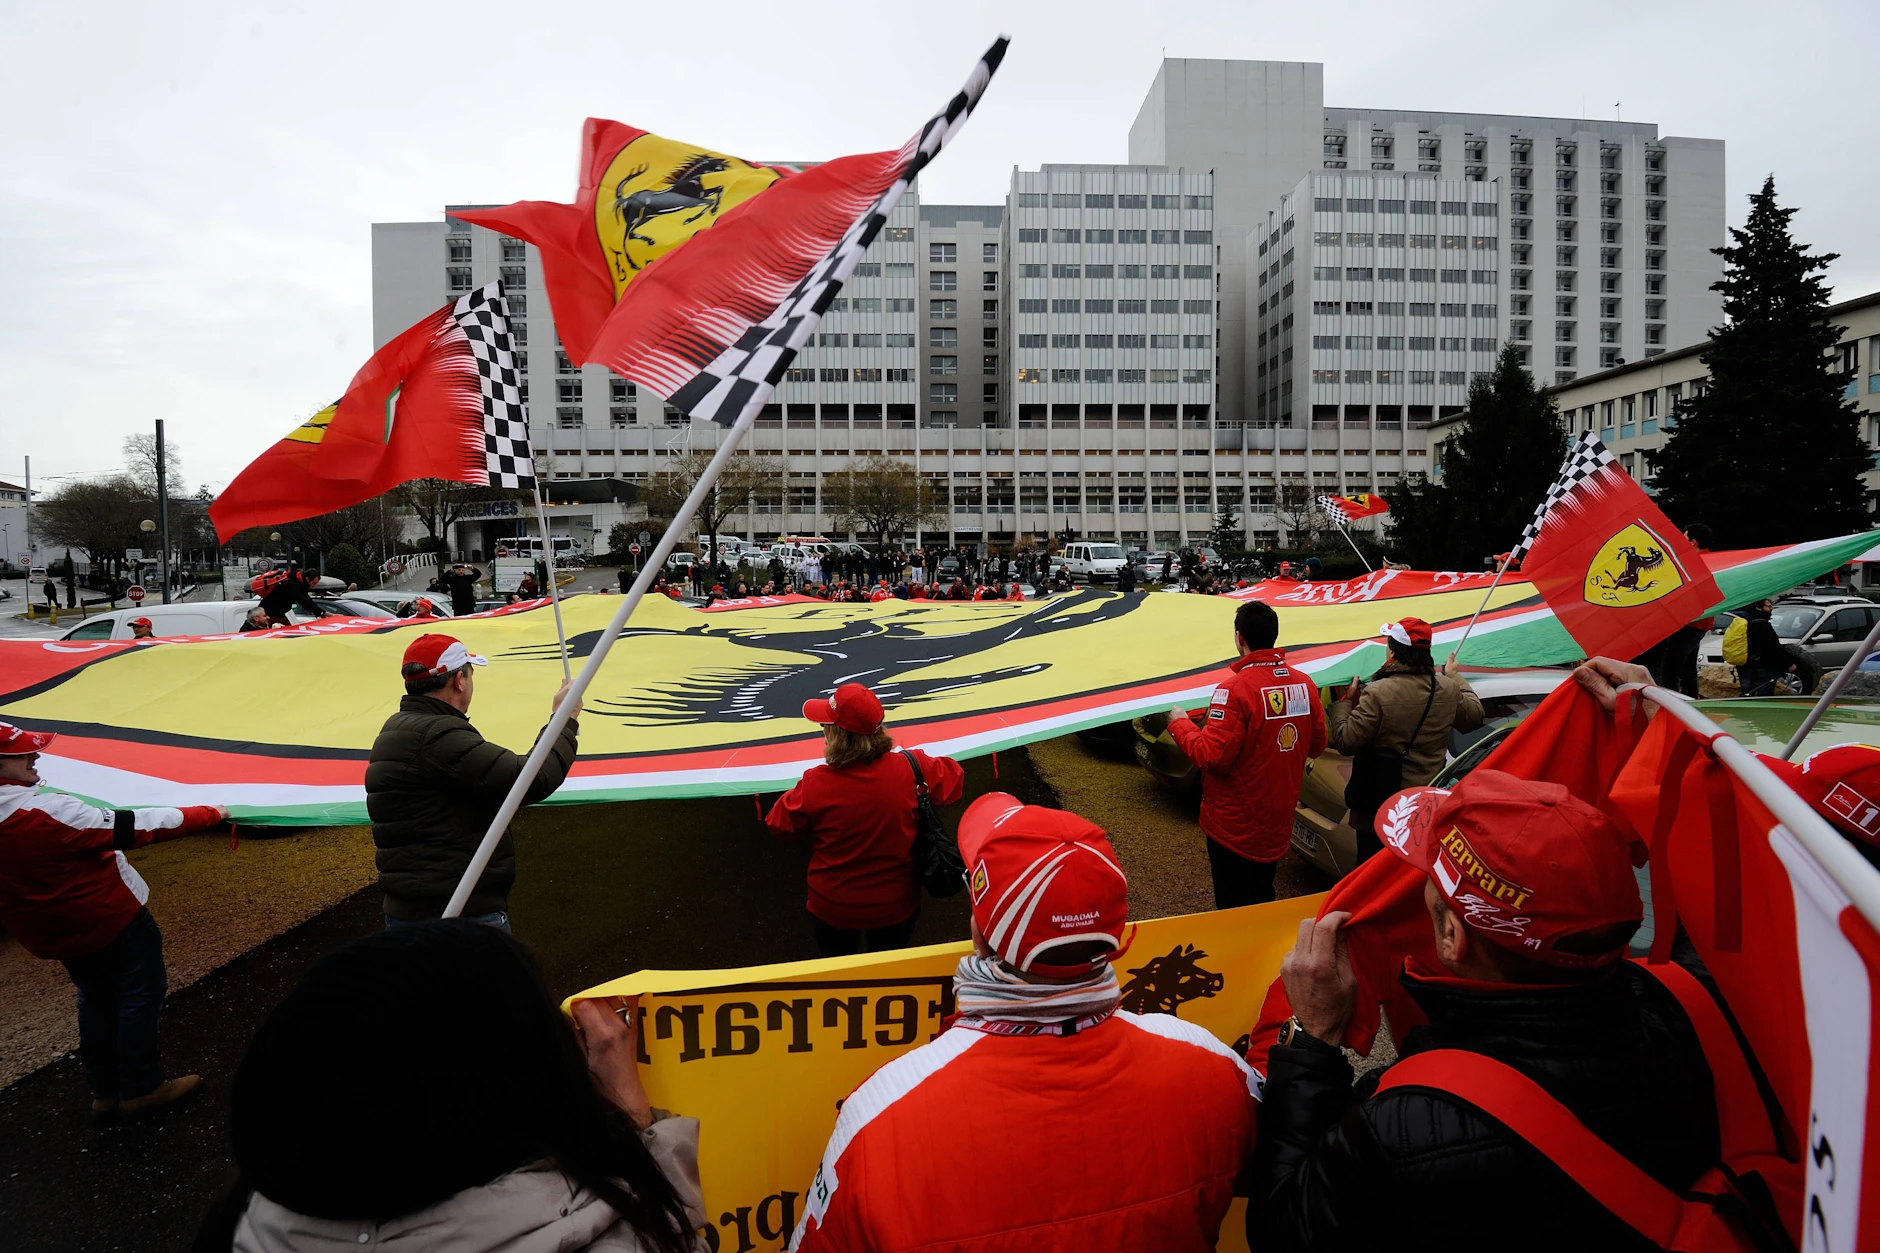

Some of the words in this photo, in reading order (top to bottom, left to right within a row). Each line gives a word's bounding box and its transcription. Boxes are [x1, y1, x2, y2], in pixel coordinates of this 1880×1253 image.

[1859, 808, 1879, 827] 1
[1440, 825, 1534, 910] Ferrari
[1052, 911, 1100, 922] MUBADALA
